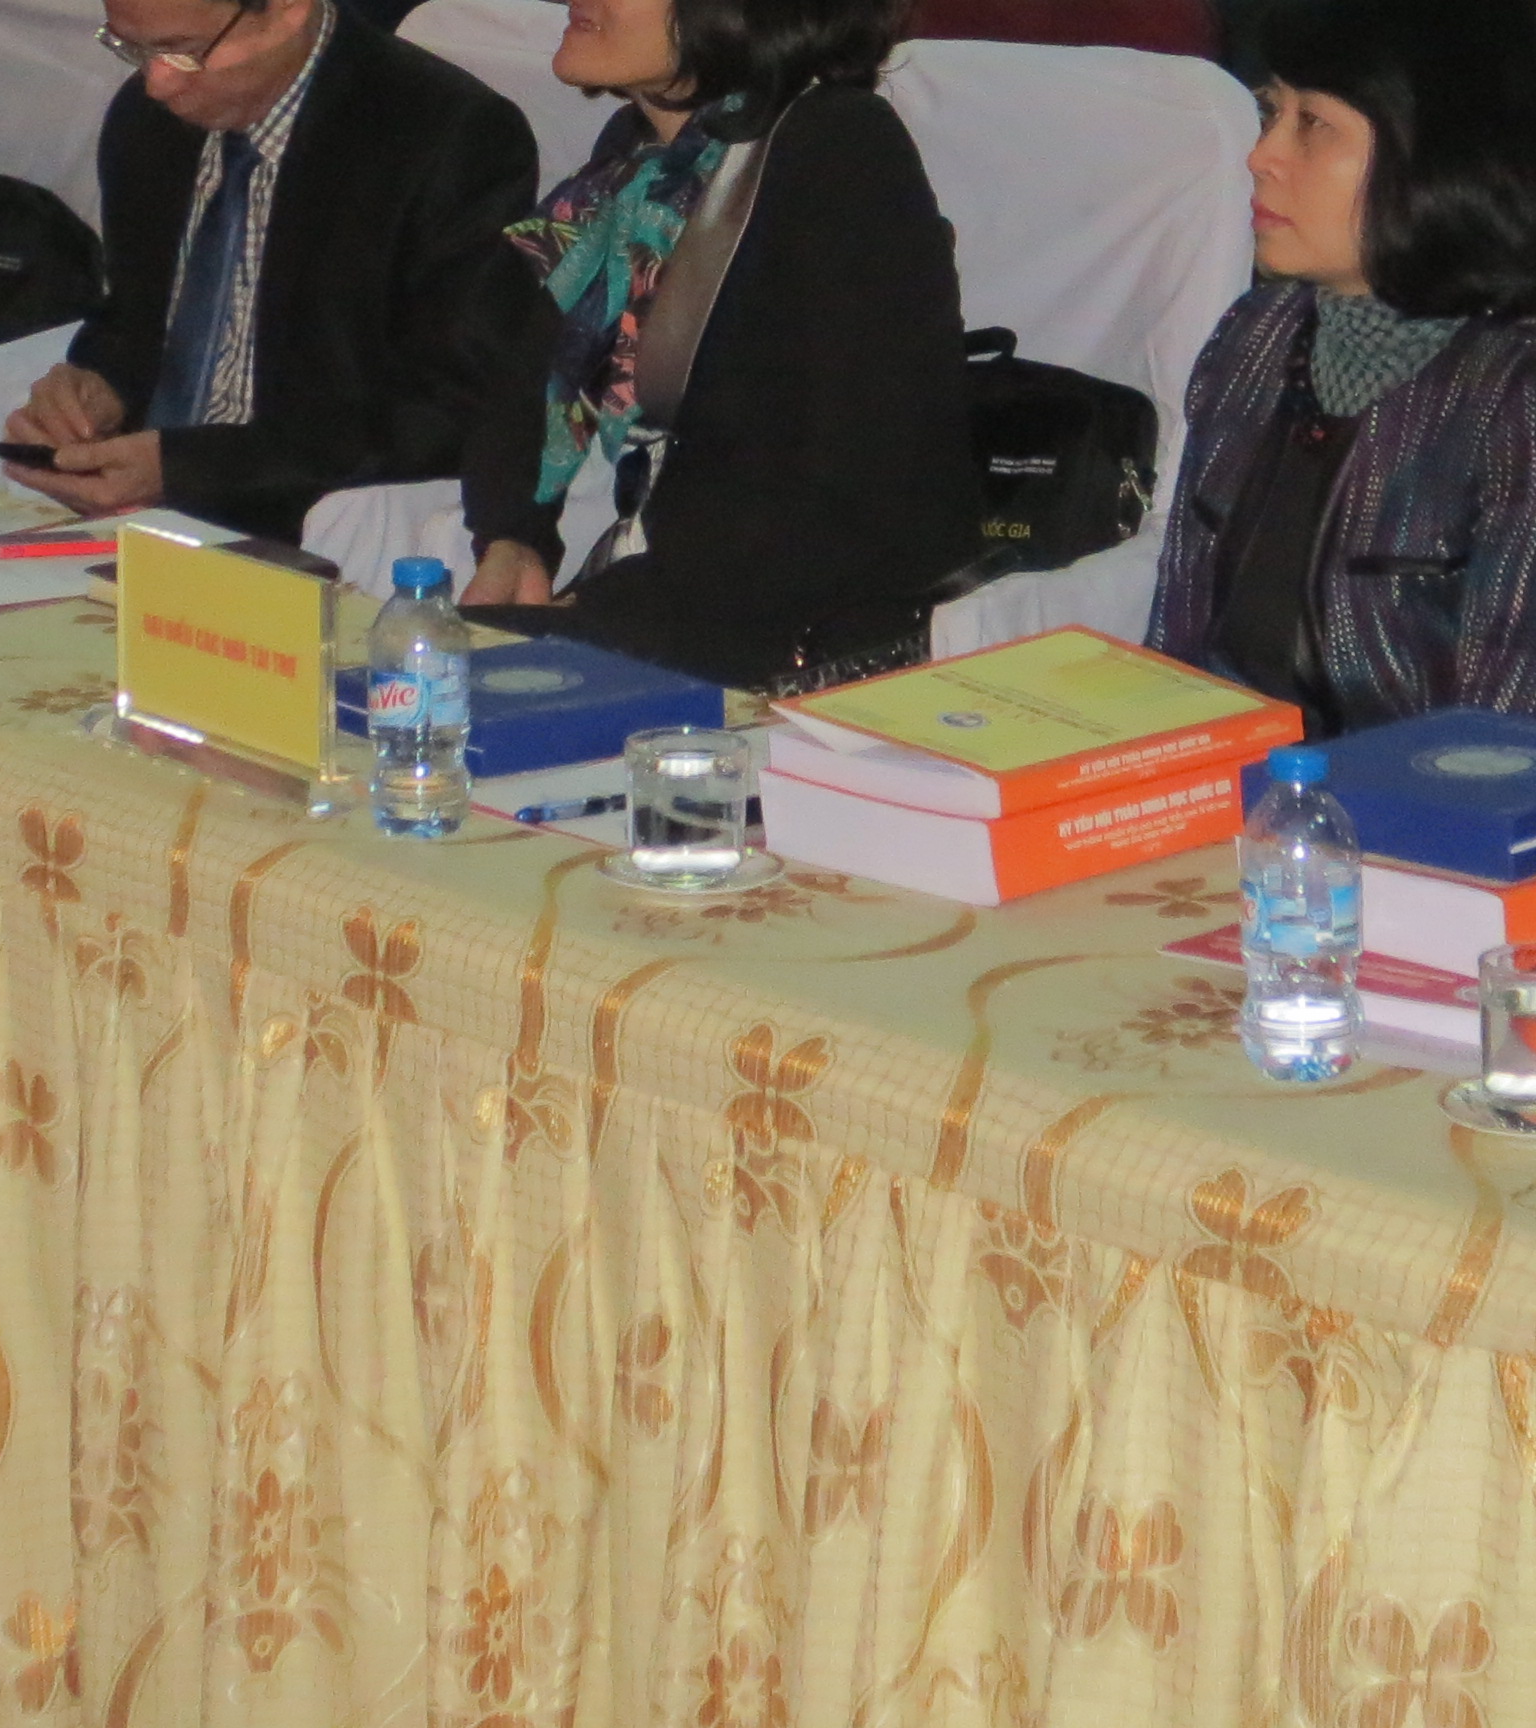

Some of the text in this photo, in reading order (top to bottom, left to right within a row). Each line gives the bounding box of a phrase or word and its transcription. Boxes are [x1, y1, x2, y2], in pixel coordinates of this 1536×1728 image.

[1008, 523, 1031, 539] GIA
[1058, 818, 1072, 838] KỶ
[1074, 813, 1094, 833] YẾU
[1113, 802, 1140, 822] THẢO
[1140, 796, 1168, 815] KHOA
[1168, 790, 1188, 809] HỌC
[1215, 779, 1232, 796] GIA
